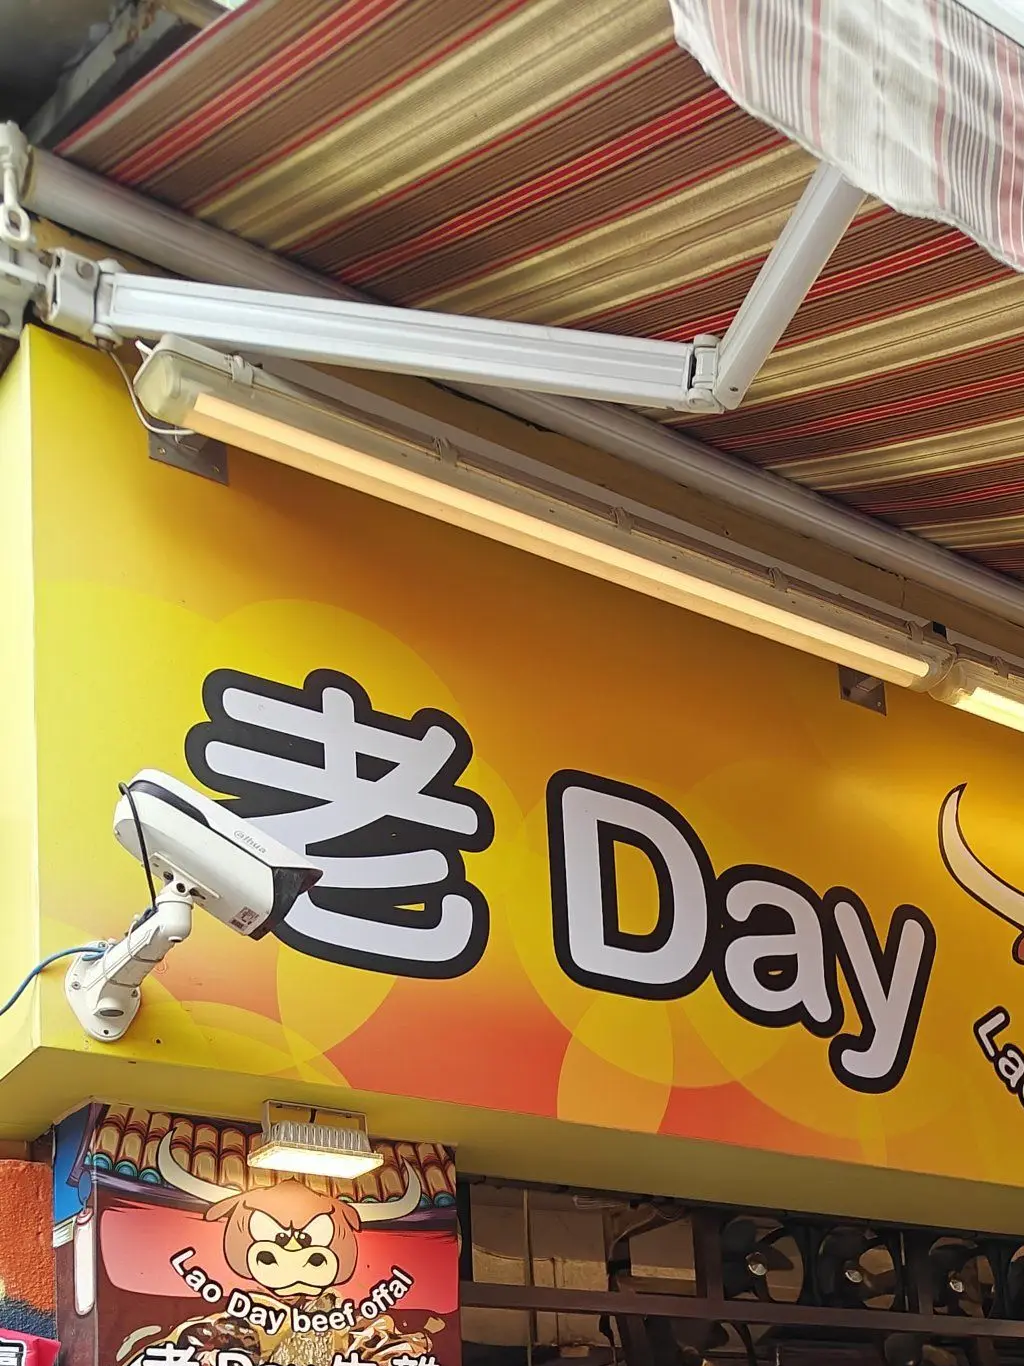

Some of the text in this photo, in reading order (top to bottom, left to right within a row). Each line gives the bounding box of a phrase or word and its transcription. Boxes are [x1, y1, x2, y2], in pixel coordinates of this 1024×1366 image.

[170, 1246, 415, 1335] Lao Day beef offal
